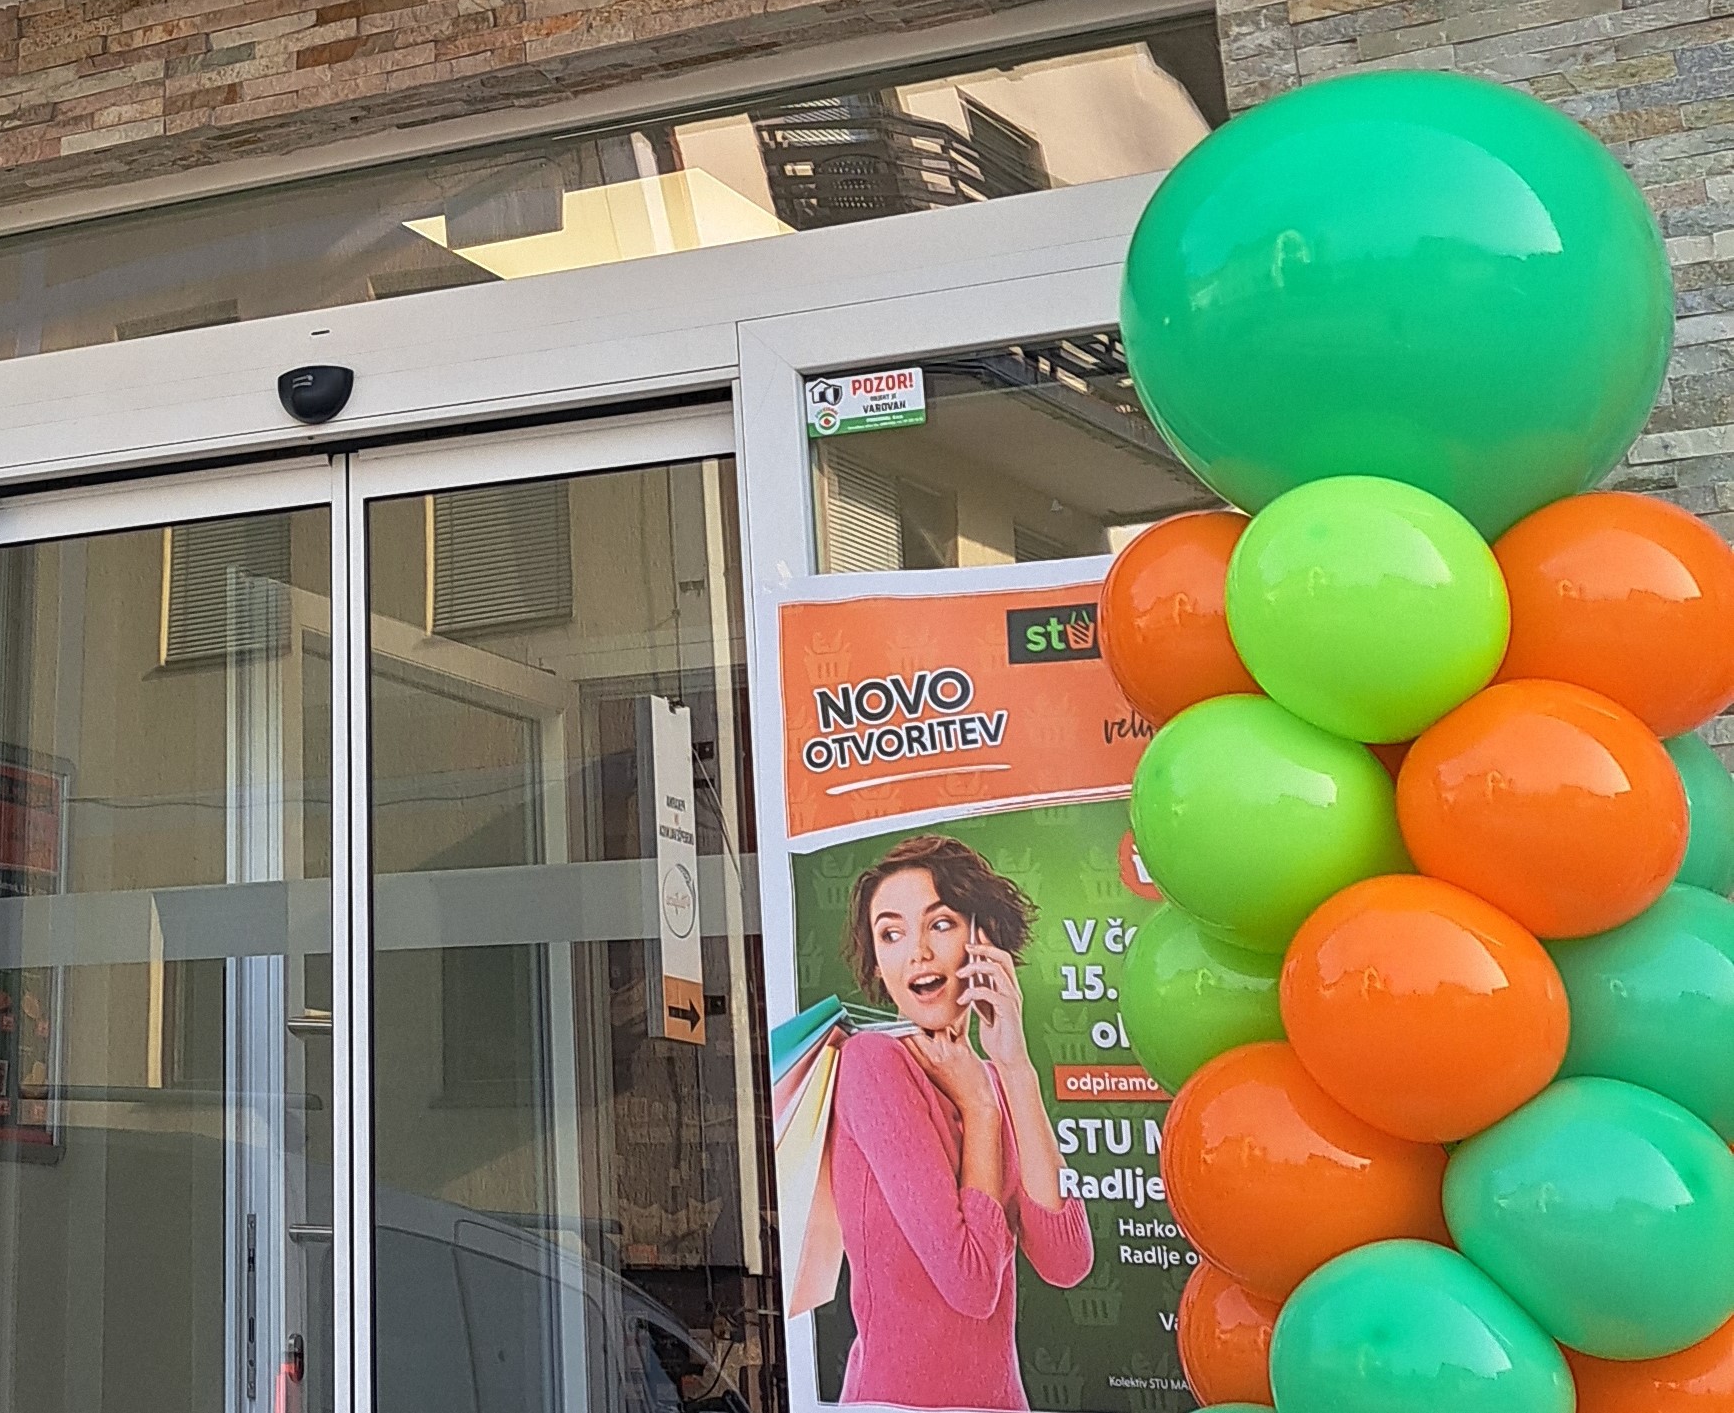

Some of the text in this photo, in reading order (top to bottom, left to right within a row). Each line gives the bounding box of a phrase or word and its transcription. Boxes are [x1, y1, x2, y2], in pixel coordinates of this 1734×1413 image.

[851, 372, 914, 396] POZOR!
[863, 400, 906, 414] VAROVAN
[815, 669, 972, 730] NOVO
[804, 712, 1006, 770] OTVORITEV
[1063, 919, 1096, 953] V
[1061, 966, 1118, 1000] 15.
[1066, 1072, 1159, 1095] odpiramo
[1057, 1118, 1132, 1155] STU
[1059, 1167, 1165, 1208] Radlje
[1120, 1245, 1180, 1268] Radlje
[1108, 1375, 1147, 1389] Kolektiv
[1149, 1377, 1168, 1390] STU
